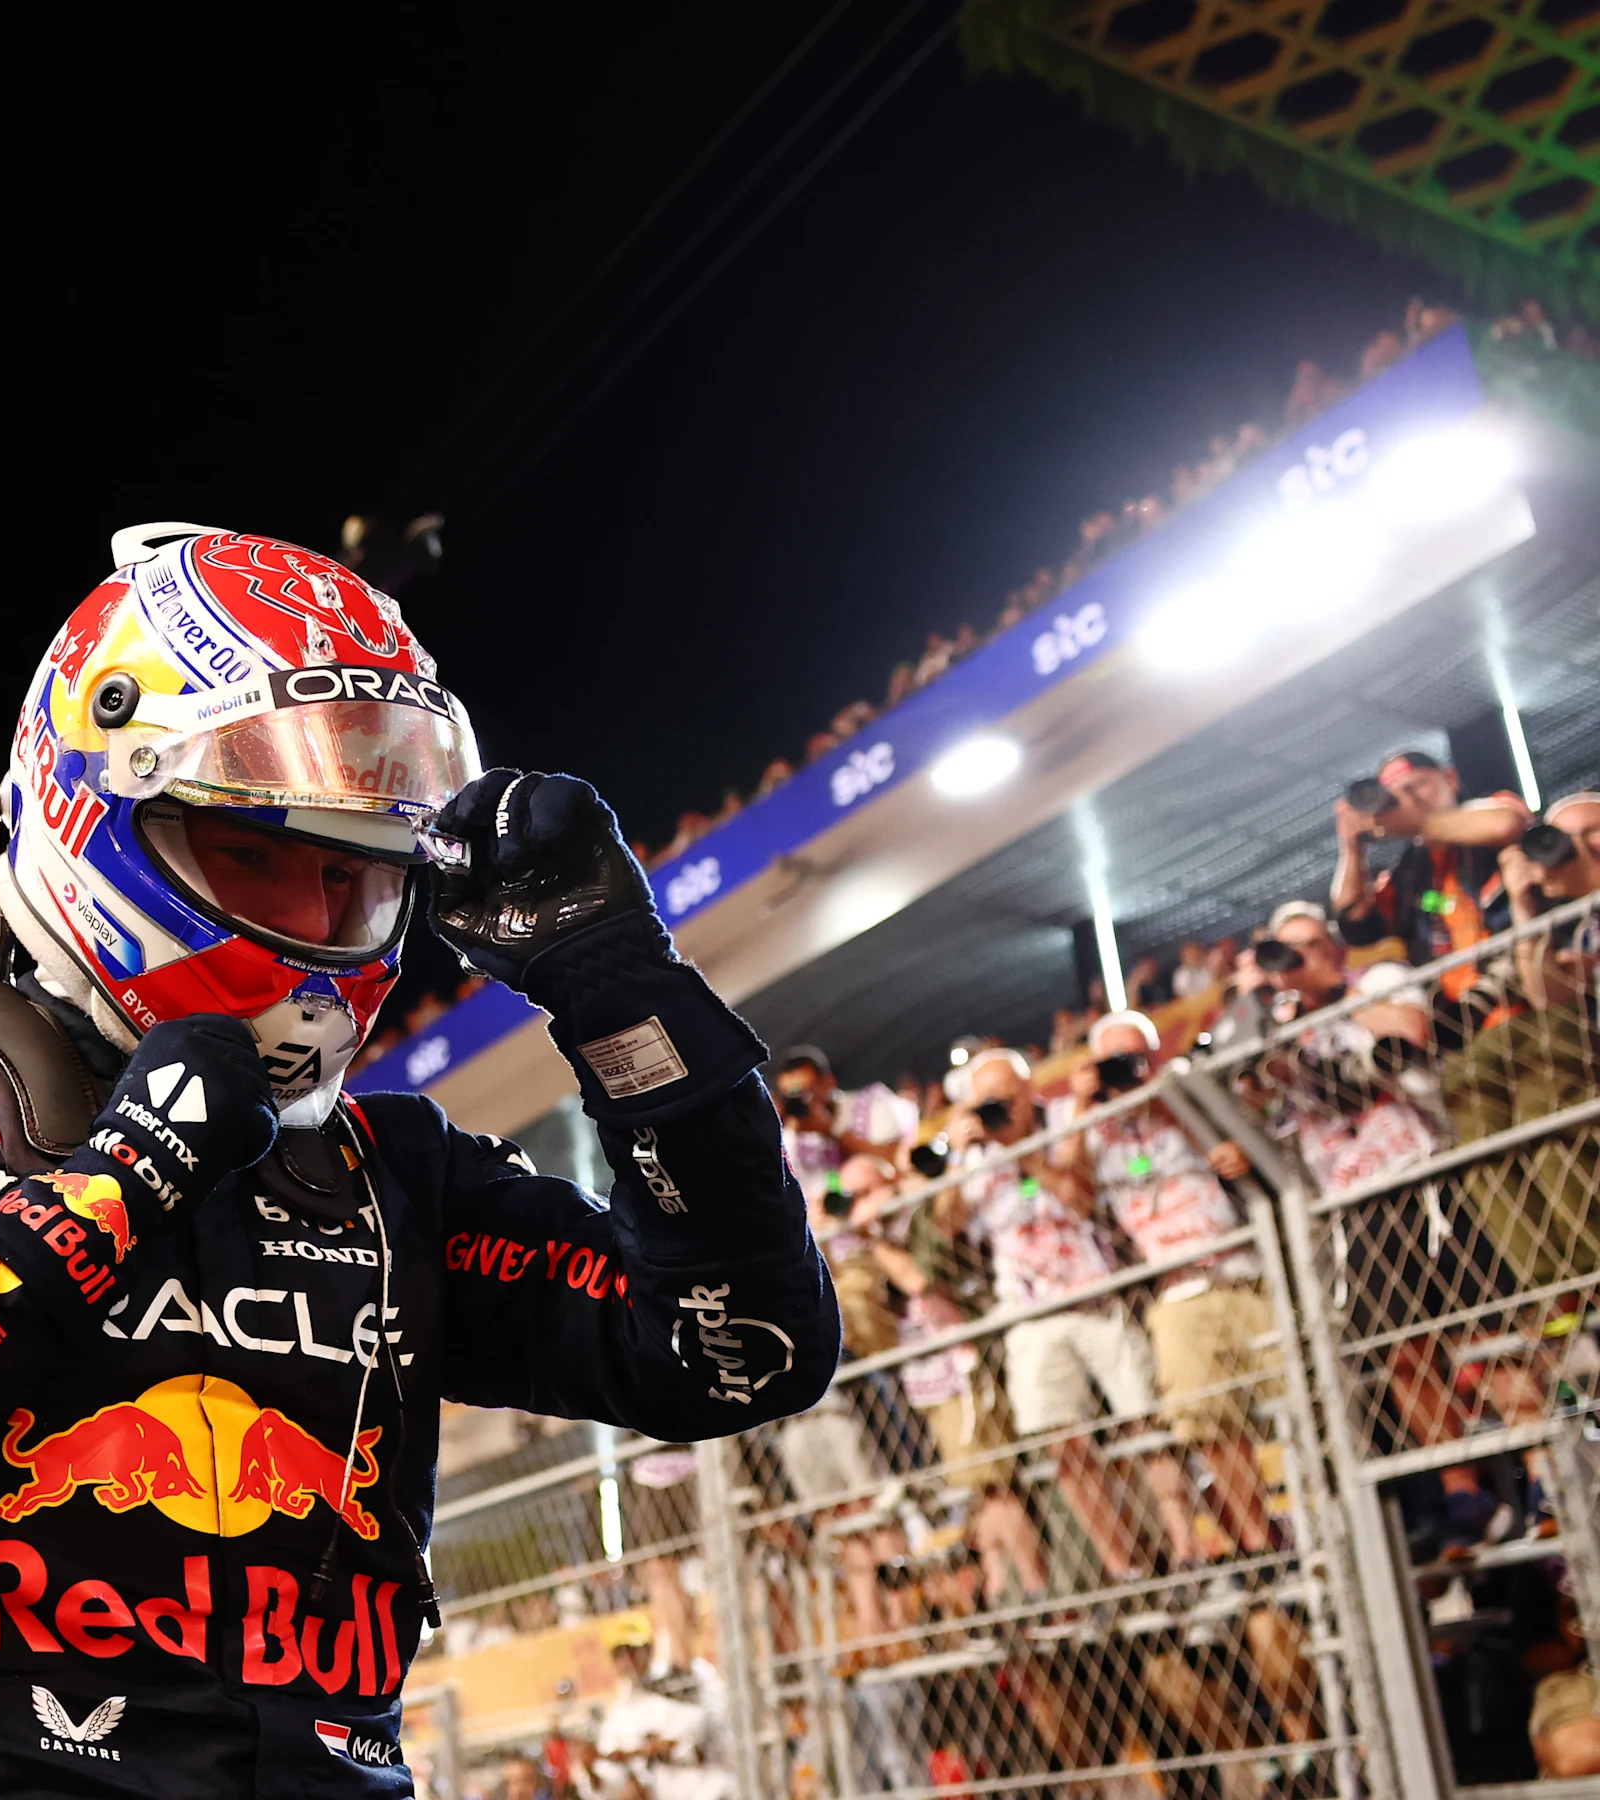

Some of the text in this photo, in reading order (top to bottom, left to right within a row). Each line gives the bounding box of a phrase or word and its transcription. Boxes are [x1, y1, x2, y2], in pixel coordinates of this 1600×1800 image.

[197, 695, 242, 720] Mobil
[285, 669, 462, 722] ORACL
[31, 733, 105, 859] Bull
[78, 899, 118, 947] viaplay
[121, 988, 165, 1029] BYB
[115, 1095, 199, 1172] inter.mx
[632, 1126, 689, 1215] sparc
[43, 1218, 116, 1304] Bull
[547, 1240, 613, 1299] YOU
[241, 1565, 401, 1697] Bull
[40, 1736, 121, 1762] CASTORE
[352, 1736, 397, 1767] MAX
